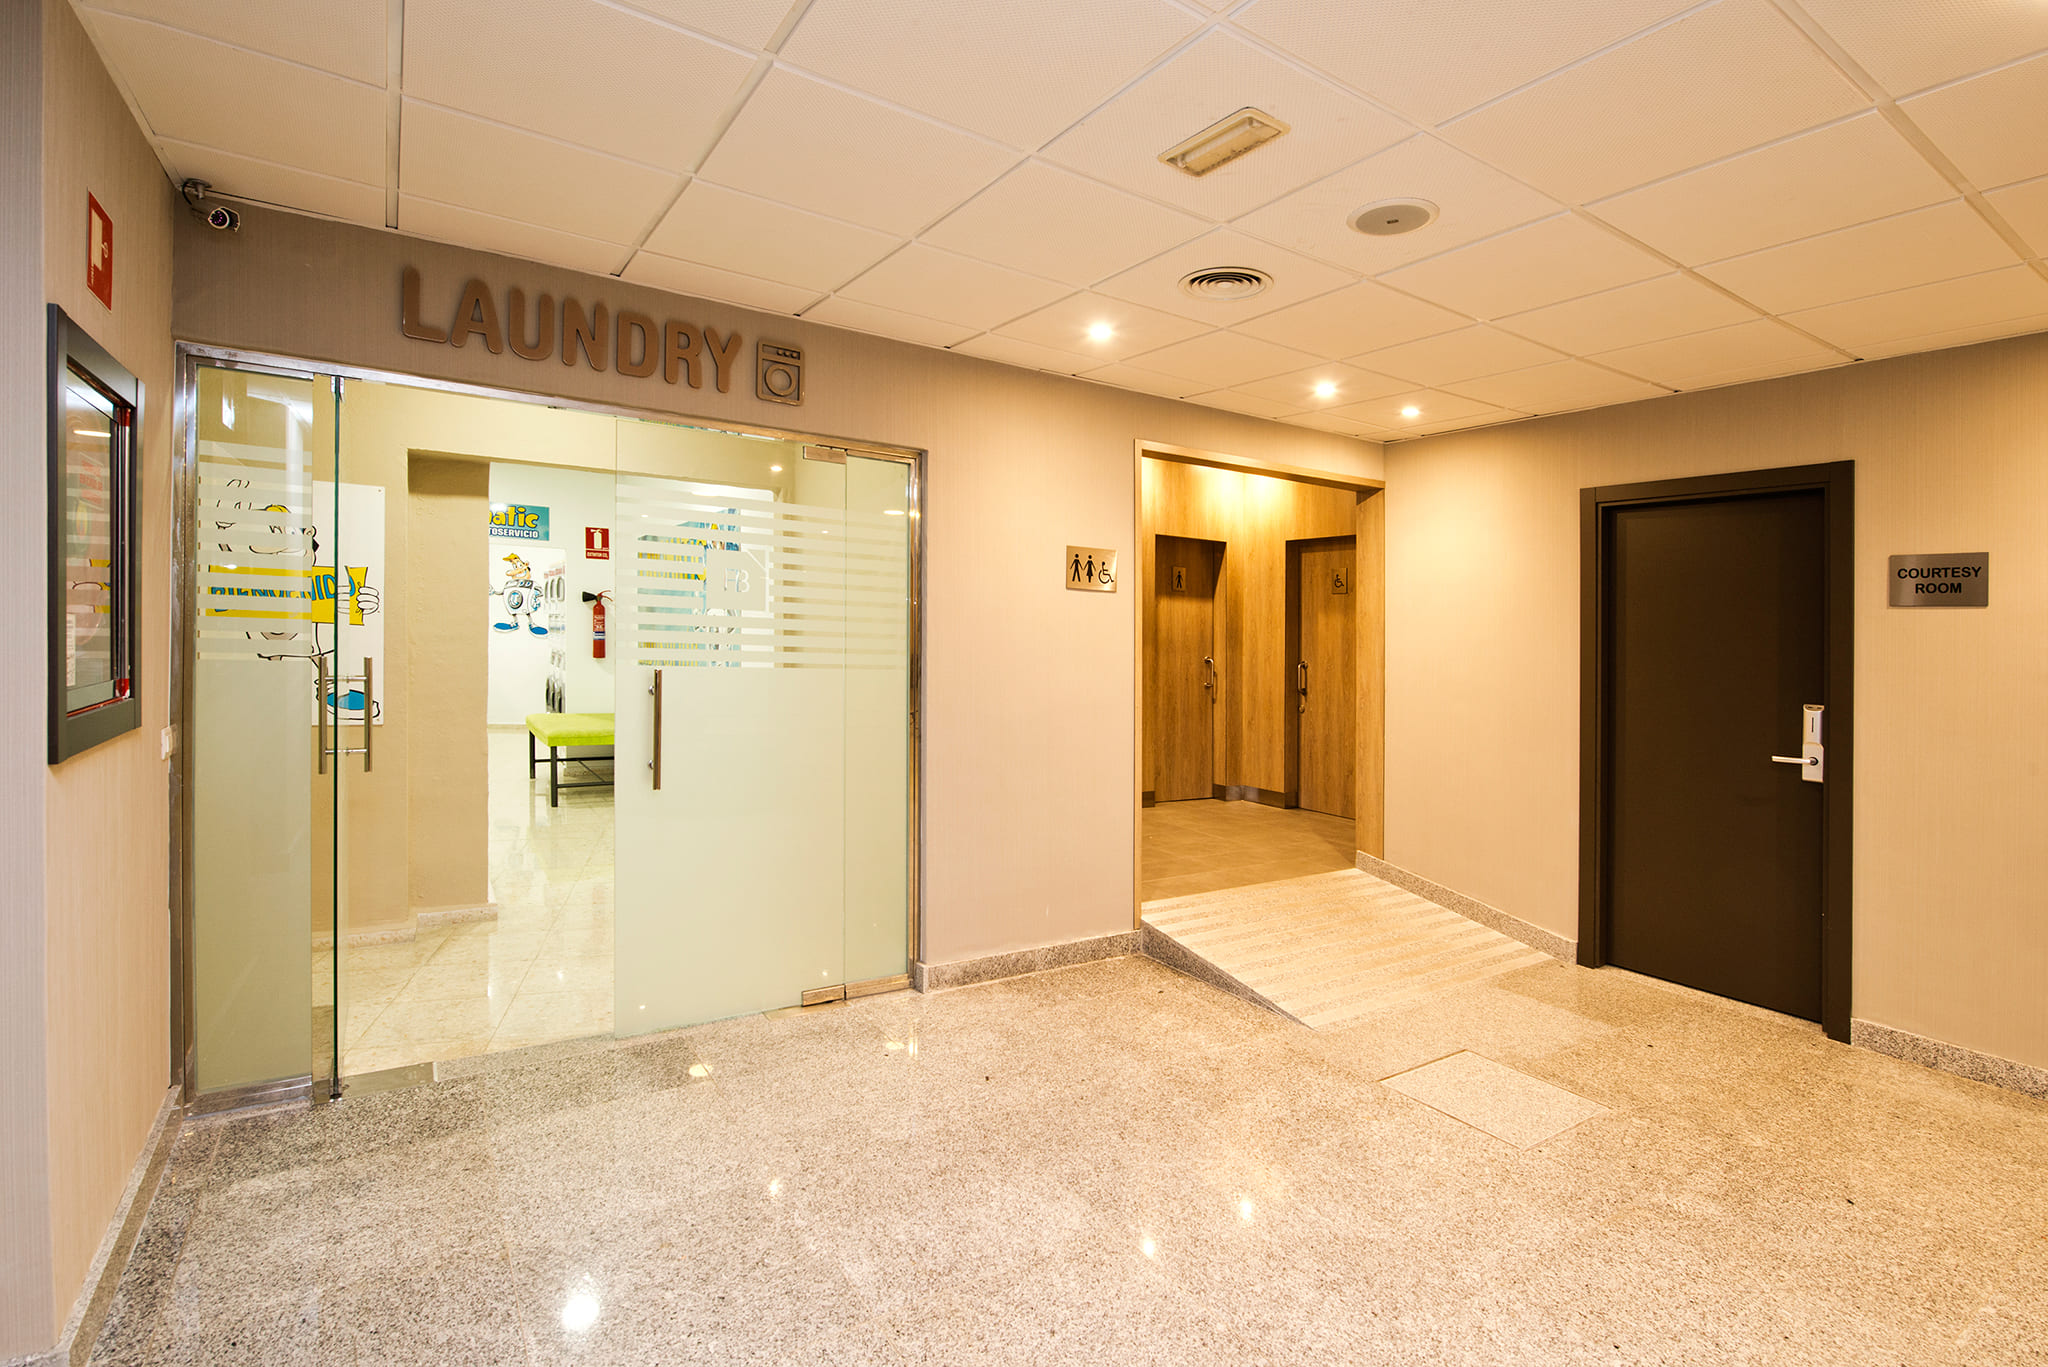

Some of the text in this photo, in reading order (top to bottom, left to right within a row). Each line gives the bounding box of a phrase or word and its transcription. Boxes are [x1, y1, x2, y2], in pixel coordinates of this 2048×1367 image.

[402, 265, 743, 394] LAUNDRY
[1897, 566, 1981, 579] COURTESY
[1915, 582, 1962, 594] ROOM
